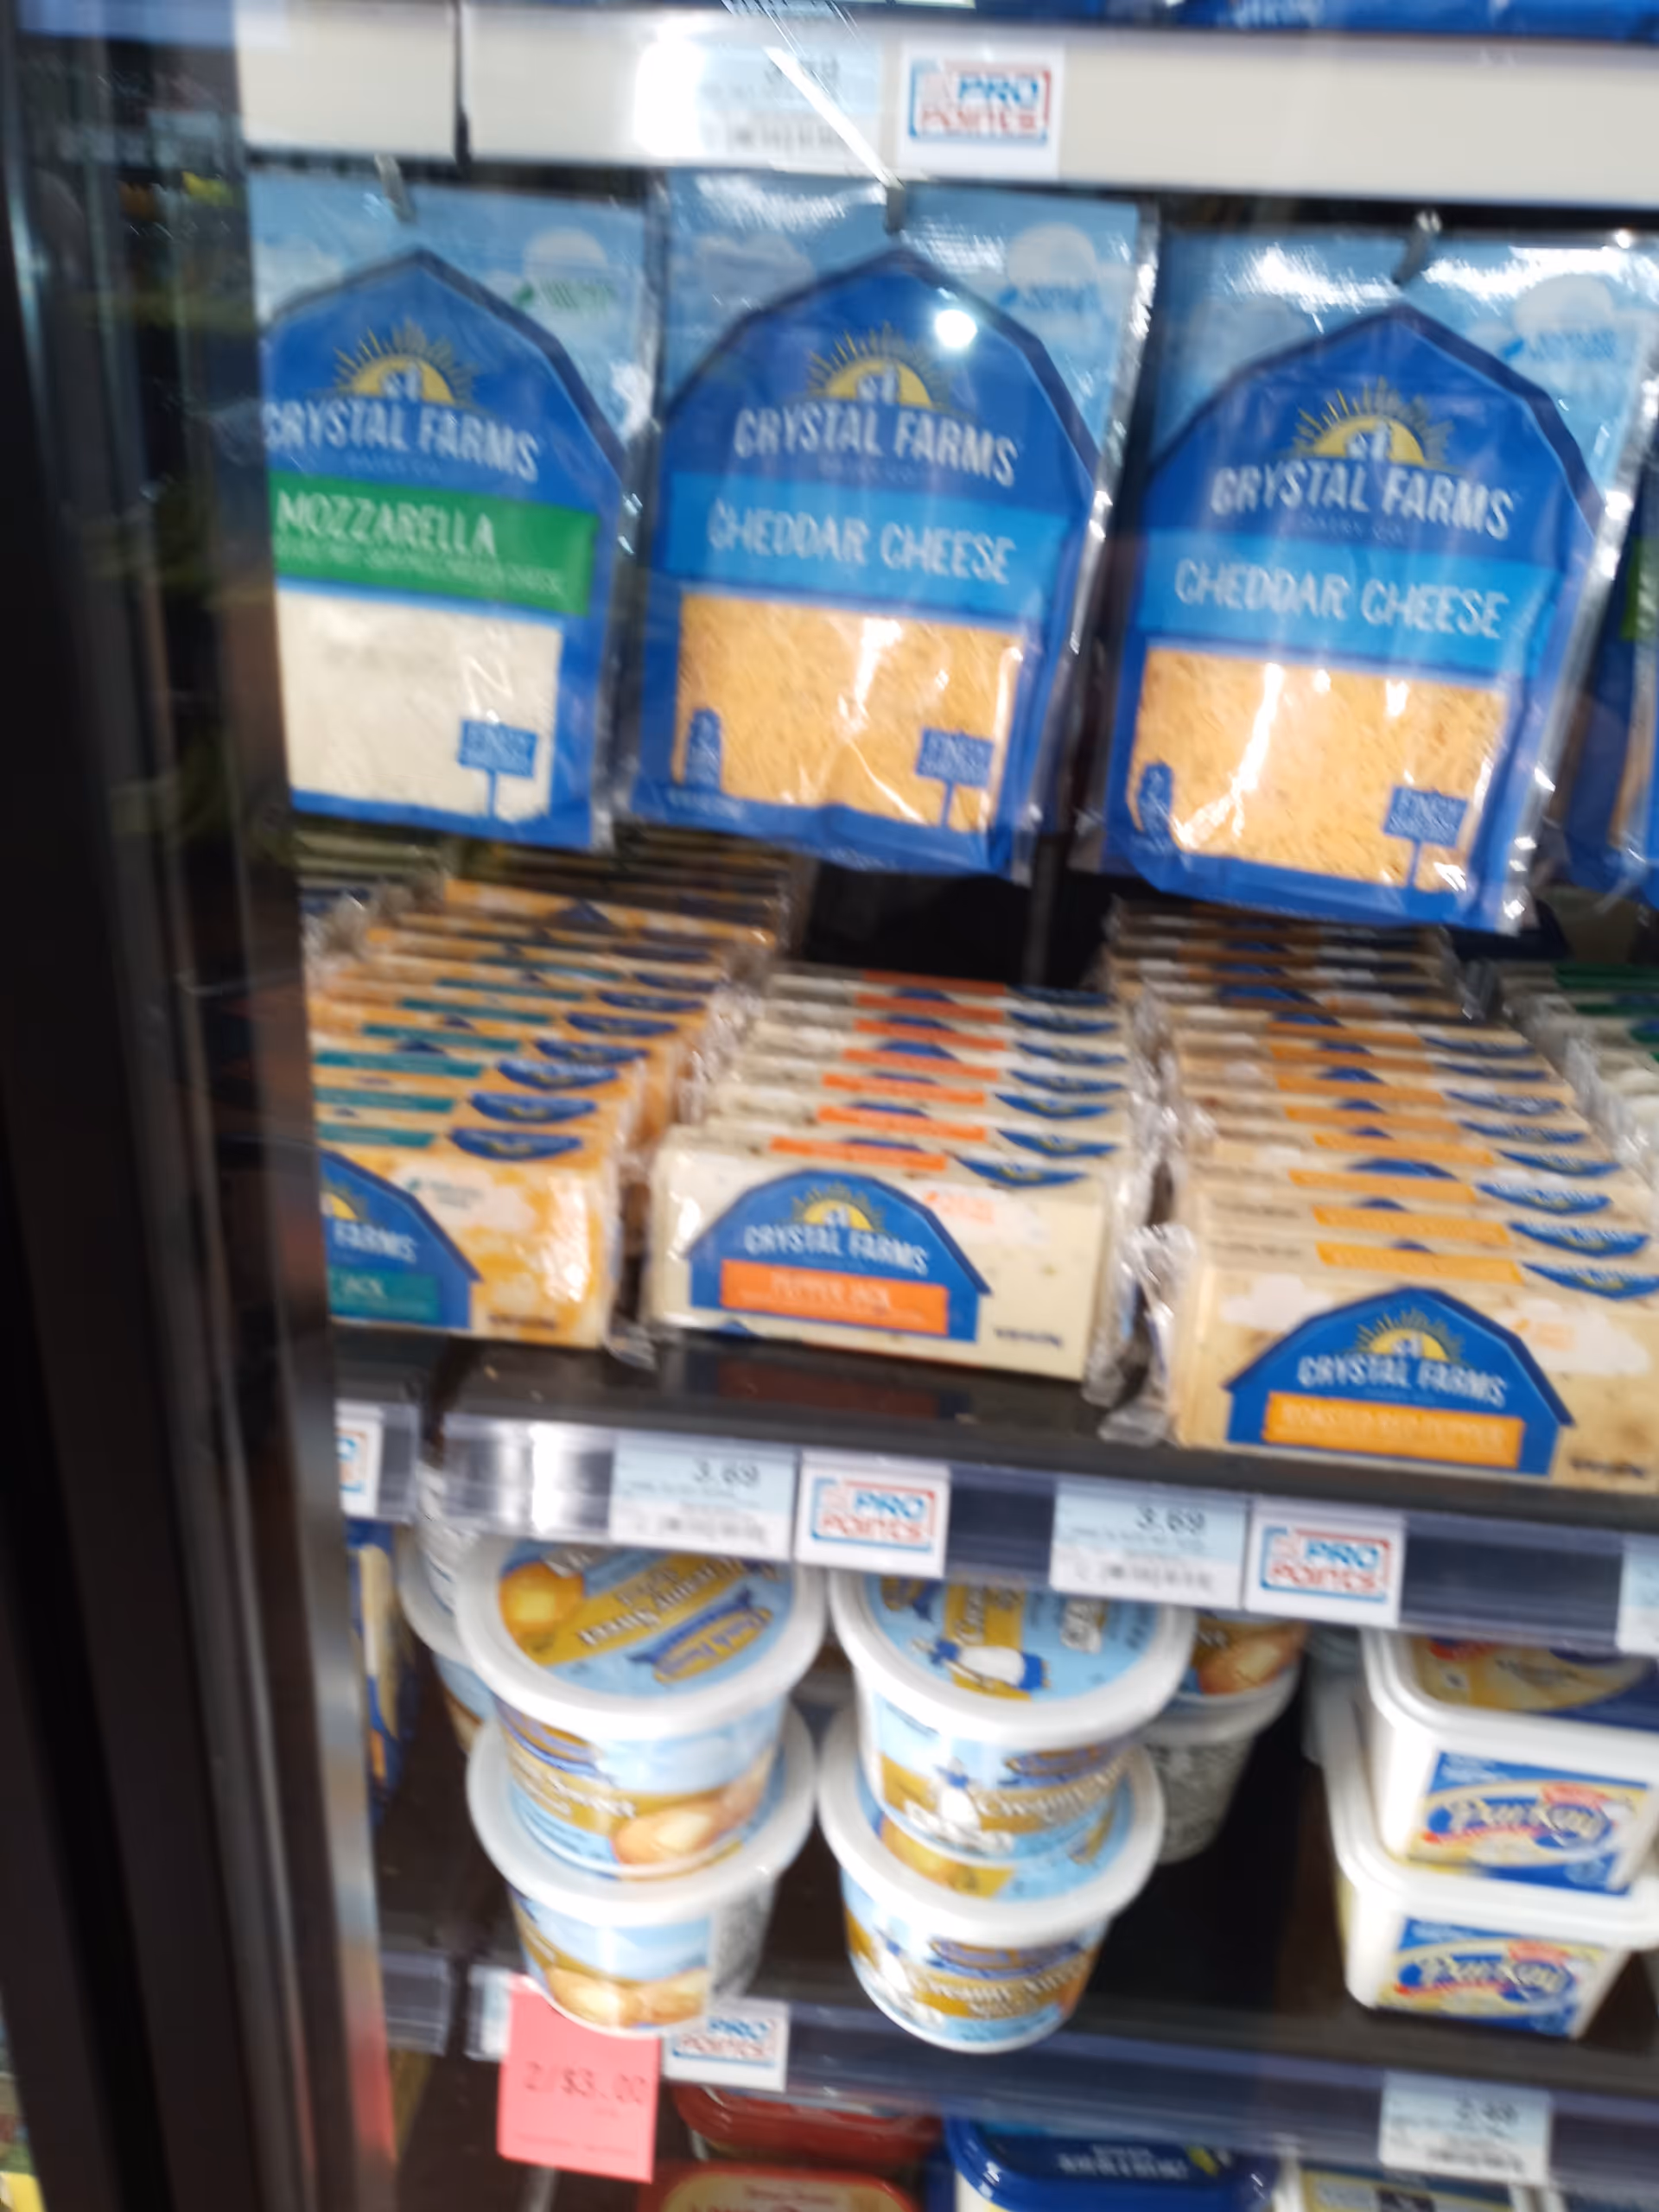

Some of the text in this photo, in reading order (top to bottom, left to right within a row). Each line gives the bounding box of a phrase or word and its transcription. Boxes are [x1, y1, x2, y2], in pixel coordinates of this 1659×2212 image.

[417, 404, 540, 484] FARMS
[734, 401, 1018, 488] CRYSTAL FARMS
[276, 489, 498, 556] MOZZARELLA
[1211, 460, 1516, 541] CRYSTAL FARMS
[707, 499, 1018, 585] CHEDDAR CHEESE
[1174, 560, 1510, 639] CHEDDAR CHEESE
[743, 1224, 928, 1276] CRYSTAL FARMS
[1297, 1355, 1507, 1409] CRYSTAL FARMS
[1304, 1538, 1381, 1571] PRO
